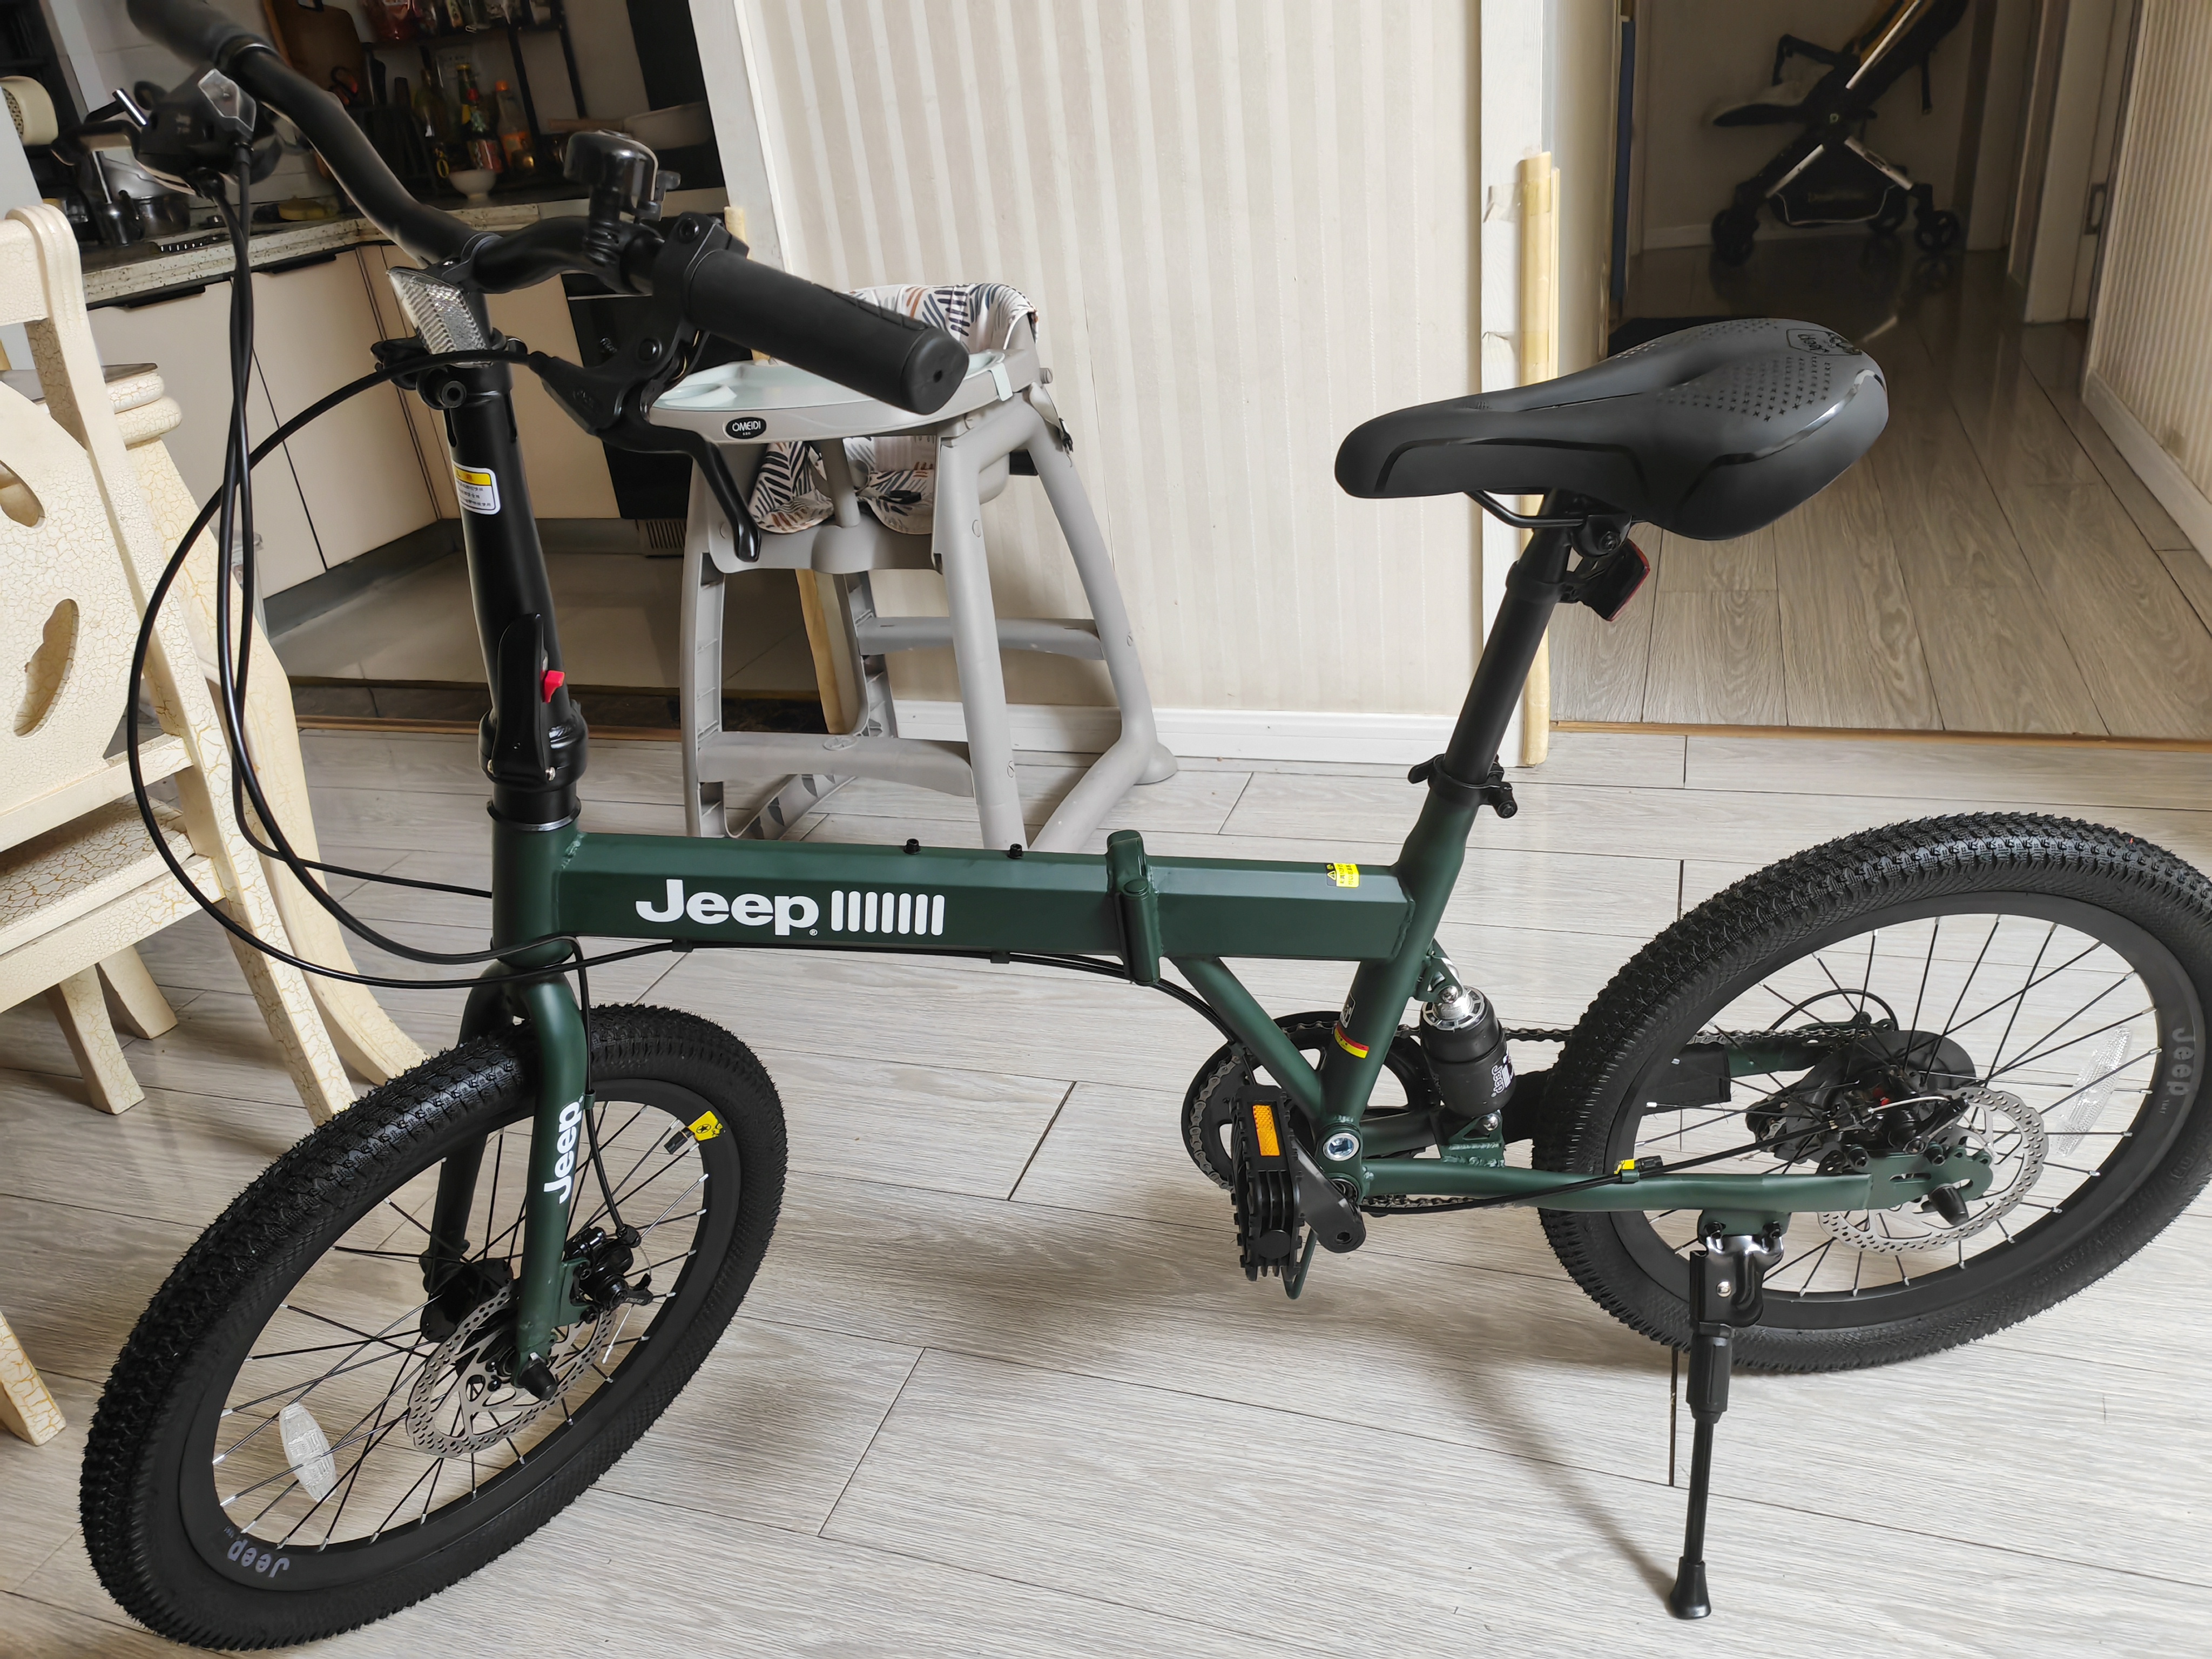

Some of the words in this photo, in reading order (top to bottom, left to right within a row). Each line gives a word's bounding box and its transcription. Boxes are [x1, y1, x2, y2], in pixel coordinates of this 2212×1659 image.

[636, 879, 819, 936] Jeep
[1491, 1065, 1505, 1093] Jeep
[2167, 1027, 2195, 1096] Jeep
[543, 1101, 583, 1204] Jeep
[227, 1539, 290, 1578] Jeep
